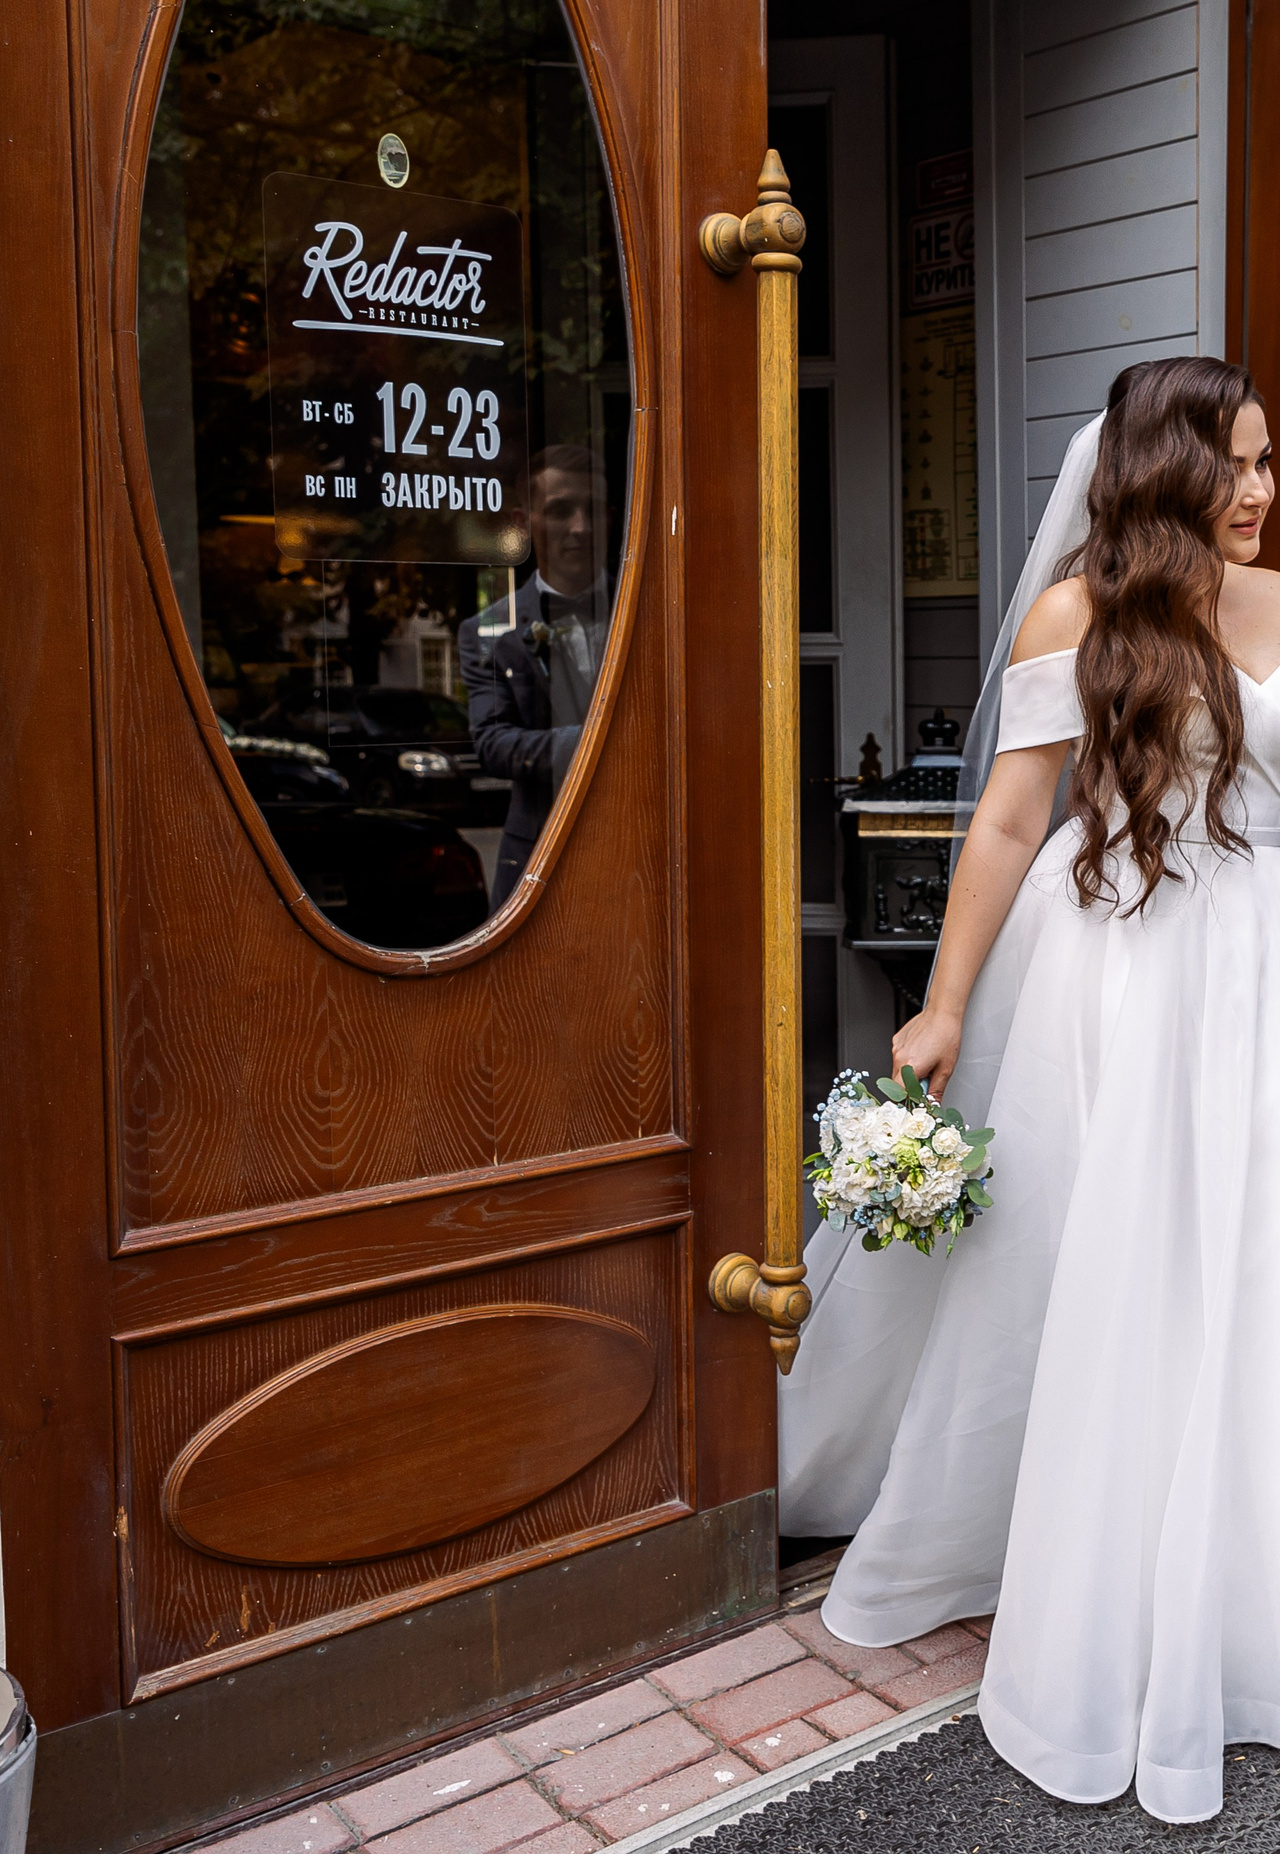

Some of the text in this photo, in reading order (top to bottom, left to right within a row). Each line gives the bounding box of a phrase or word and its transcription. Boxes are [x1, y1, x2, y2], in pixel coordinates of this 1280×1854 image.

[302, 221, 492, 320] Redactor
[915, 222, 951, 264] НЕ
[376, 381, 501, 461] 12-23
[305, 471, 502, 513] ВС ПН ЗАКРЫТО
